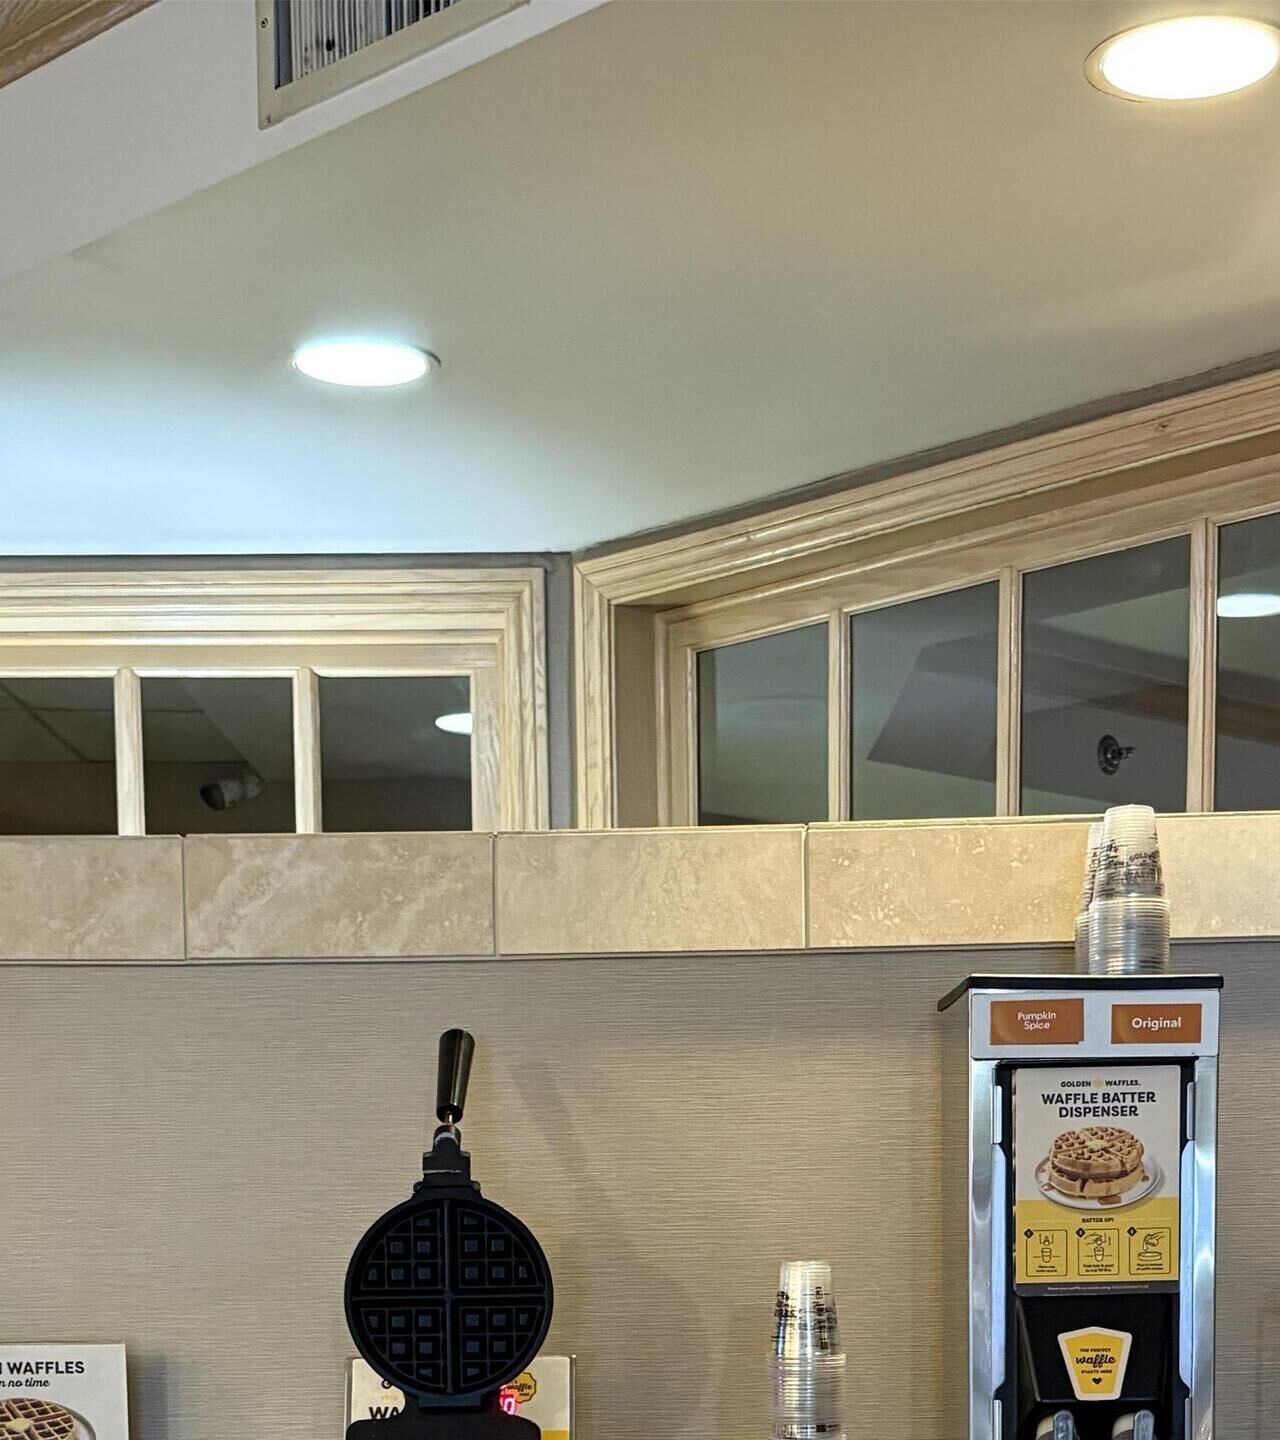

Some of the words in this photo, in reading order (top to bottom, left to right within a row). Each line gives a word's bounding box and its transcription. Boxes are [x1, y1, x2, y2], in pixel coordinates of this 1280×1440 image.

[1017, 1011, 1057, 1022] Pumpkin
[1023, 1020, 1050, 1030] Spice
[1131, 1017, 1182, 1032] Original
[1060, 1080, 1091, 1088] GOLDEN
[1041, 1092, 1099, 1105] WAFFLE
[1102, 1091, 1157, 1104] BATTER
[1058, 1105, 1139, 1118] DISPENSER
[1075, 1354, 1116, 1368] waffle
[6, 1361, 85, 1375] WAFFLES
[7, 1378, 23, 1388] no
[24, 1377, 50, 1388] time
